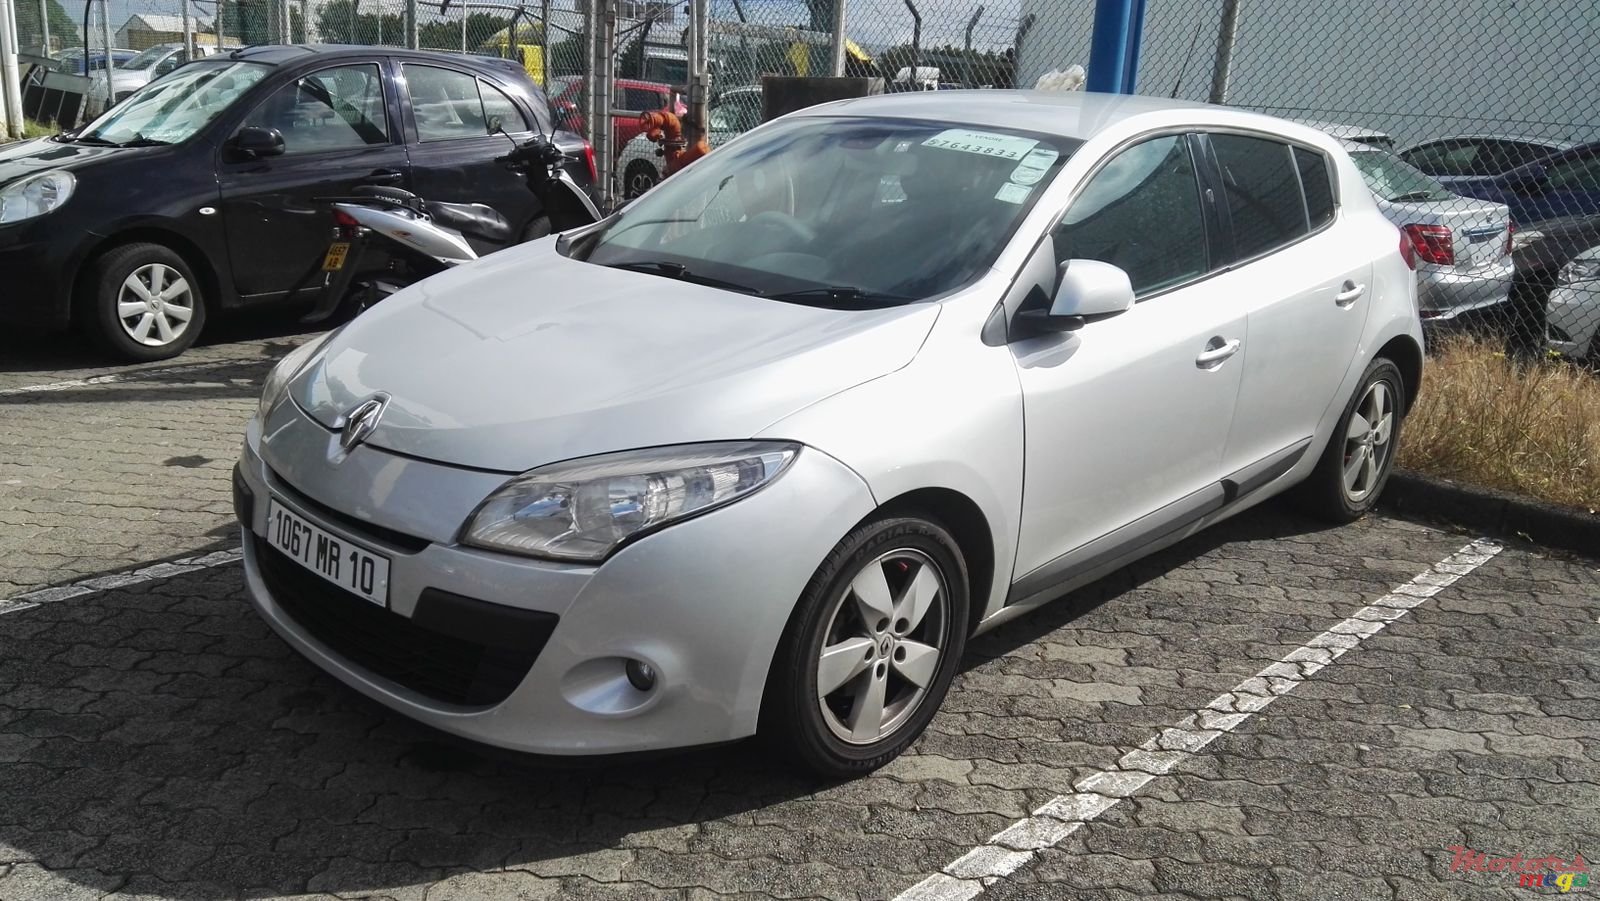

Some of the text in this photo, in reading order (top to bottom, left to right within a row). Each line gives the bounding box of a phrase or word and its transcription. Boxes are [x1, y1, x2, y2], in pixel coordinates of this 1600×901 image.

[927, 138, 1017, 158] 57643833
[276, 509, 375, 595] 1067 MR 10
[855, 525, 913, 562] RADIAL
